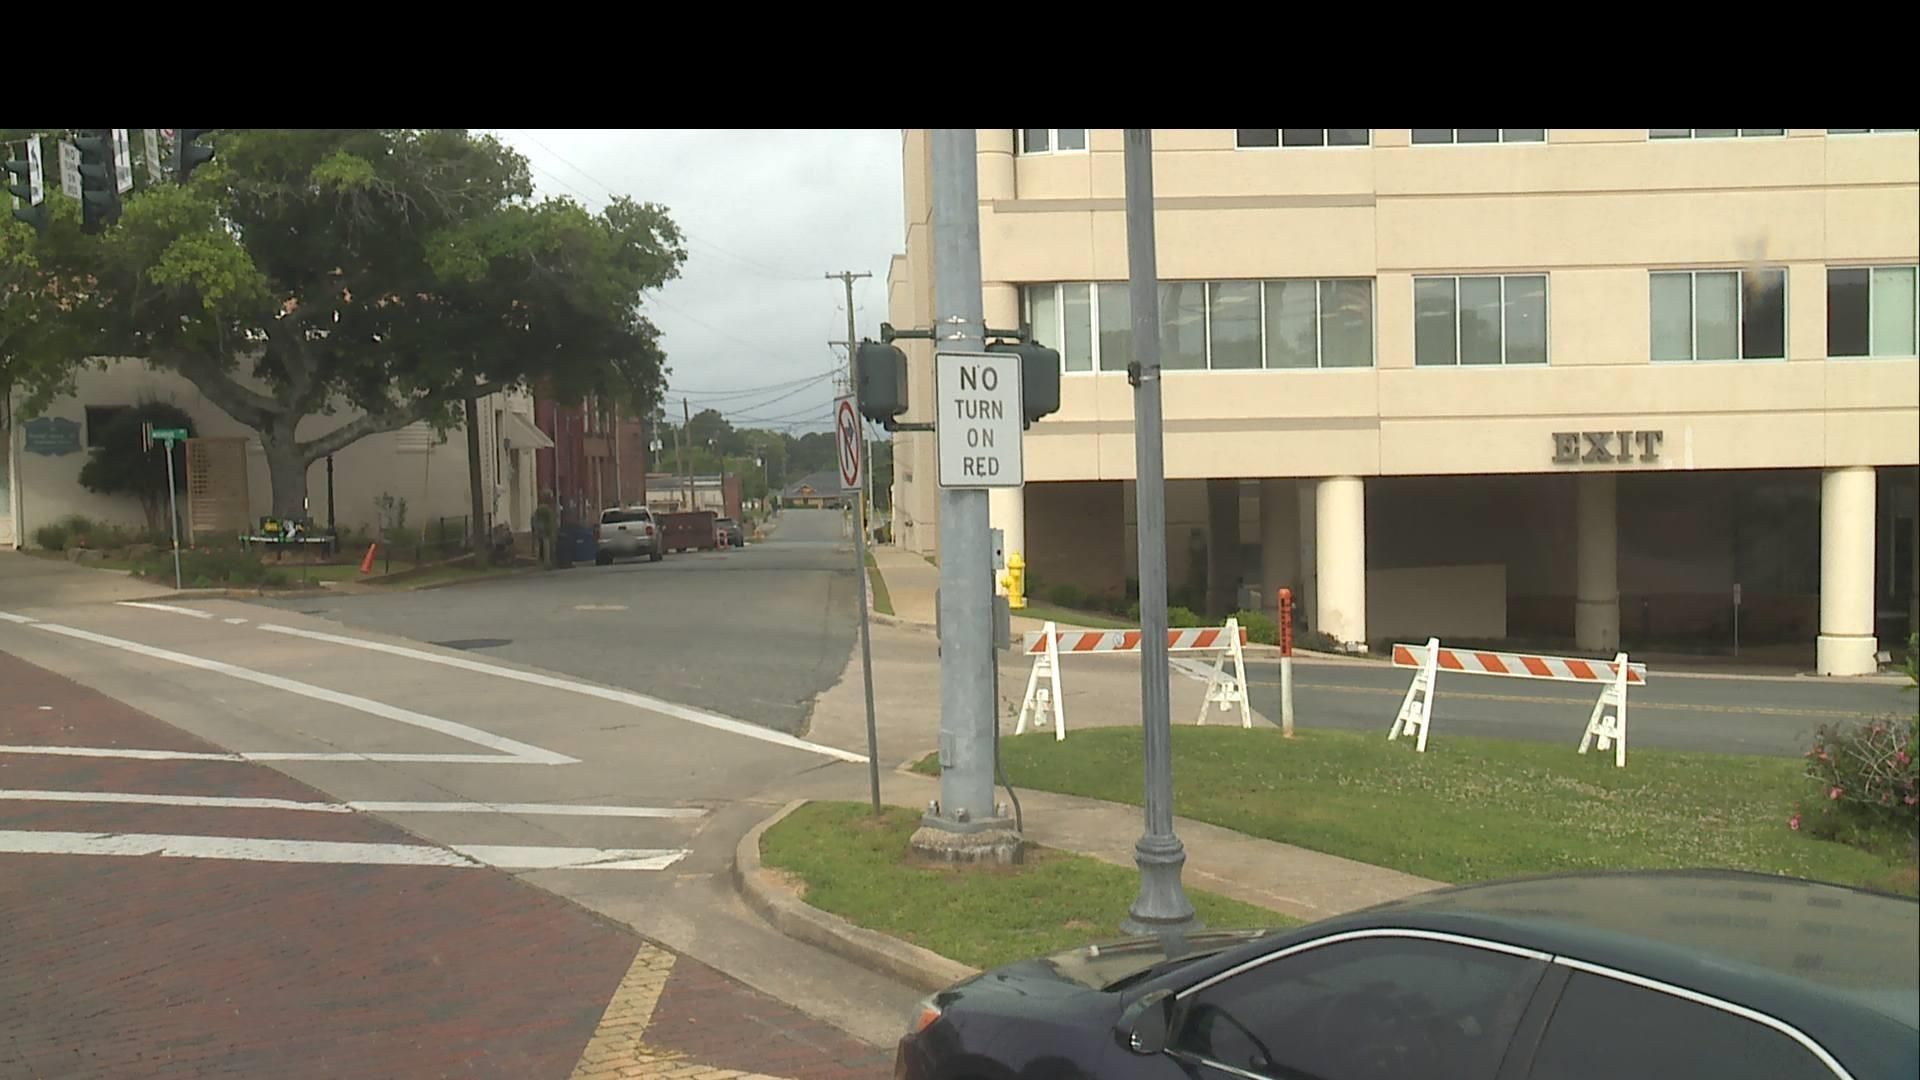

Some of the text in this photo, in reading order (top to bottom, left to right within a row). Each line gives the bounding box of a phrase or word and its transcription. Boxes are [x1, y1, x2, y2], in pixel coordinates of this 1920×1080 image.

[960, 366, 998, 391] NO
[954, 399, 1003, 420] TURN
[967, 428, 994, 448] ON
[1552, 430, 1663, 464] EXIT
[963, 457, 999, 477] RED
